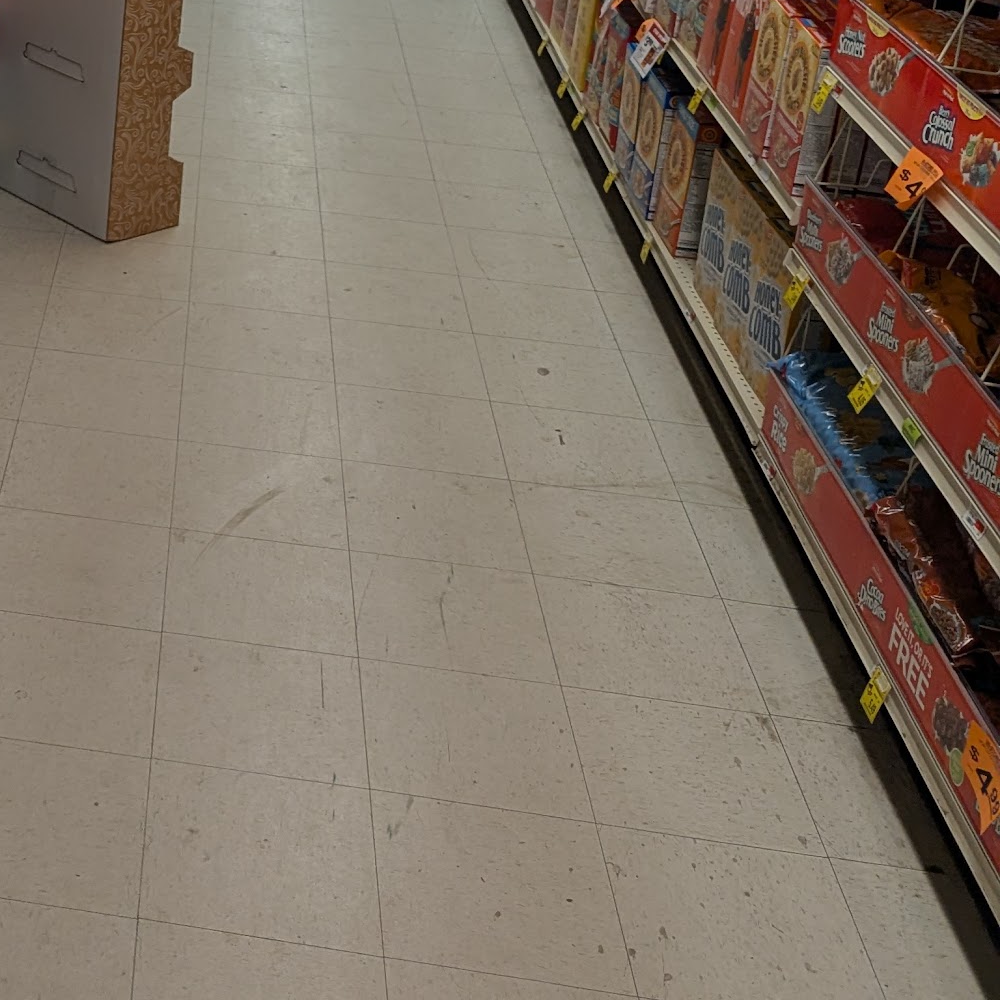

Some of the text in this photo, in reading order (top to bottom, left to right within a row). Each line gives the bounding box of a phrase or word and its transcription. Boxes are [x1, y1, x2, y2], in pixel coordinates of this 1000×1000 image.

[922, 126, 954, 150] Crunch
[750, 304, 782, 358] COMB
[867, 319, 899, 353] Spooners
[976, 445, 998, 470] Mini
[888, 626, 930, 711] FREE
